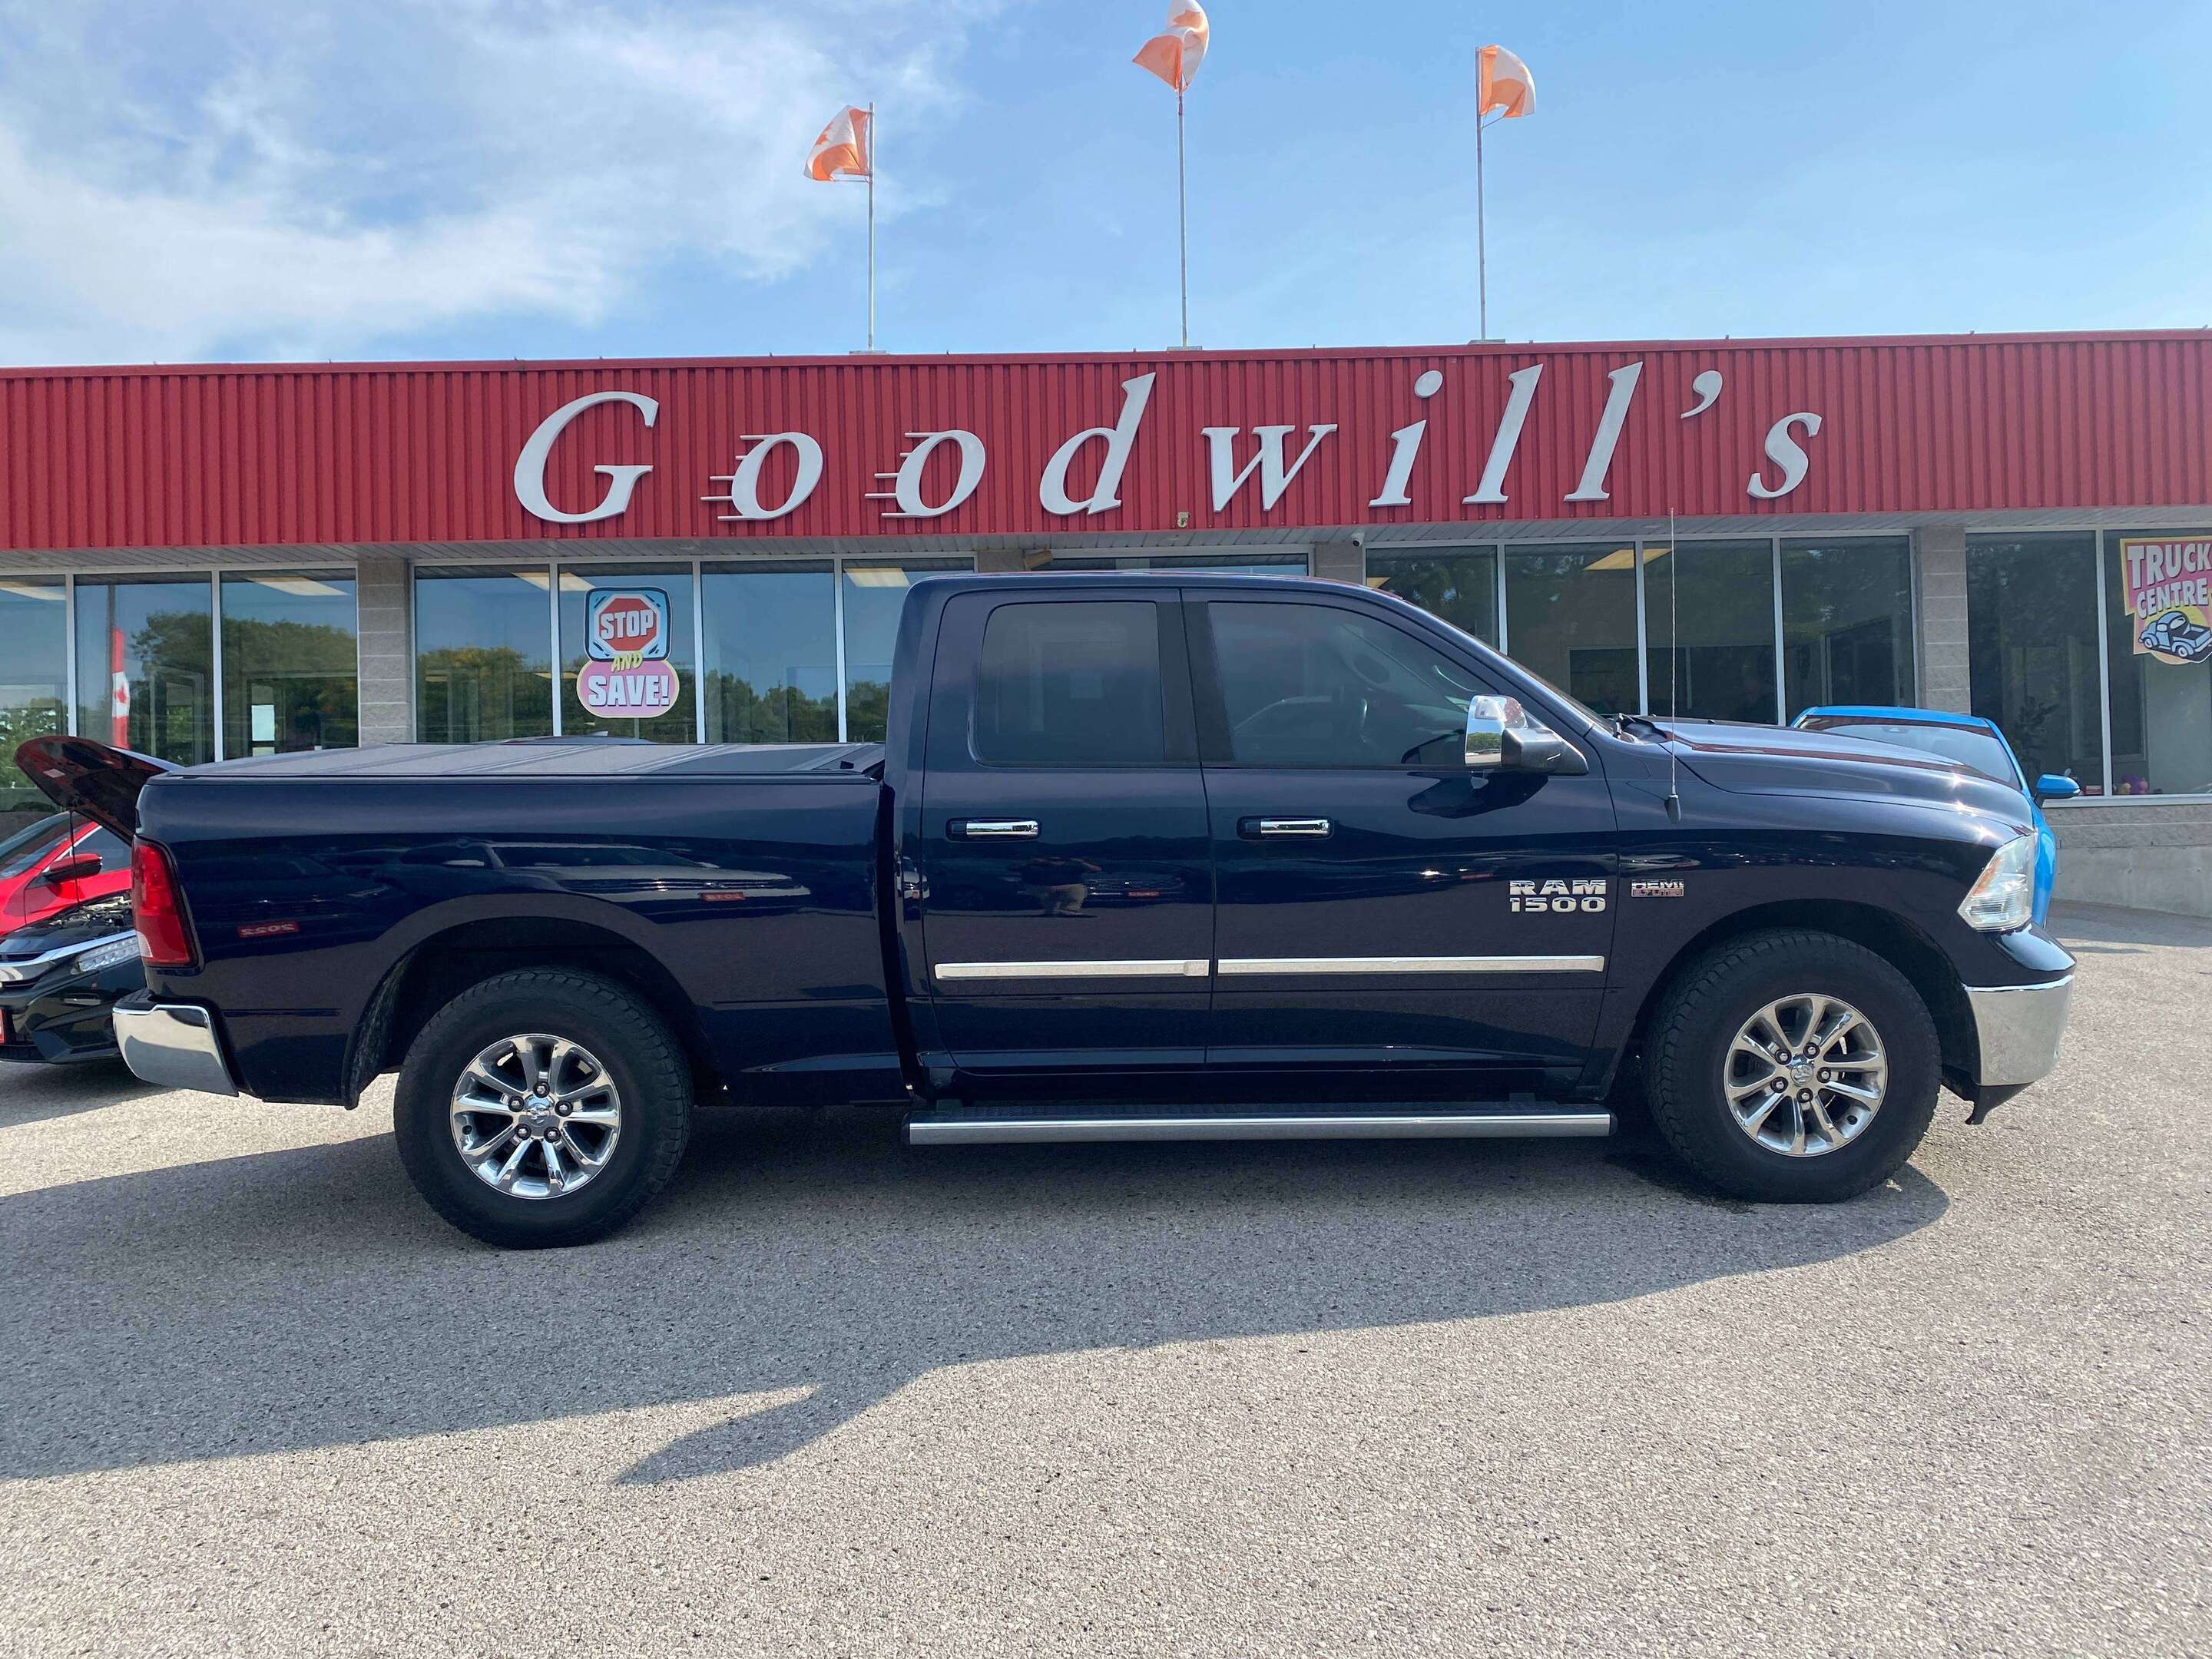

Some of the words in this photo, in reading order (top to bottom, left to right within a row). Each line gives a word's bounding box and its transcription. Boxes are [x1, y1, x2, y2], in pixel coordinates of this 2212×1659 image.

[513, 362, 1822, 524] Goodwill's
[2128, 543, 2212, 589] TRUCK
[2137, 578, 2208, 618] CENTRE
[601, 610, 653, 640] STOP
[611, 651, 643, 672] AND
[588, 675, 671, 706] SAVE!
[1509, 879, 1606, 895] RAM
[1509, 897, 1606, 912] 1500
